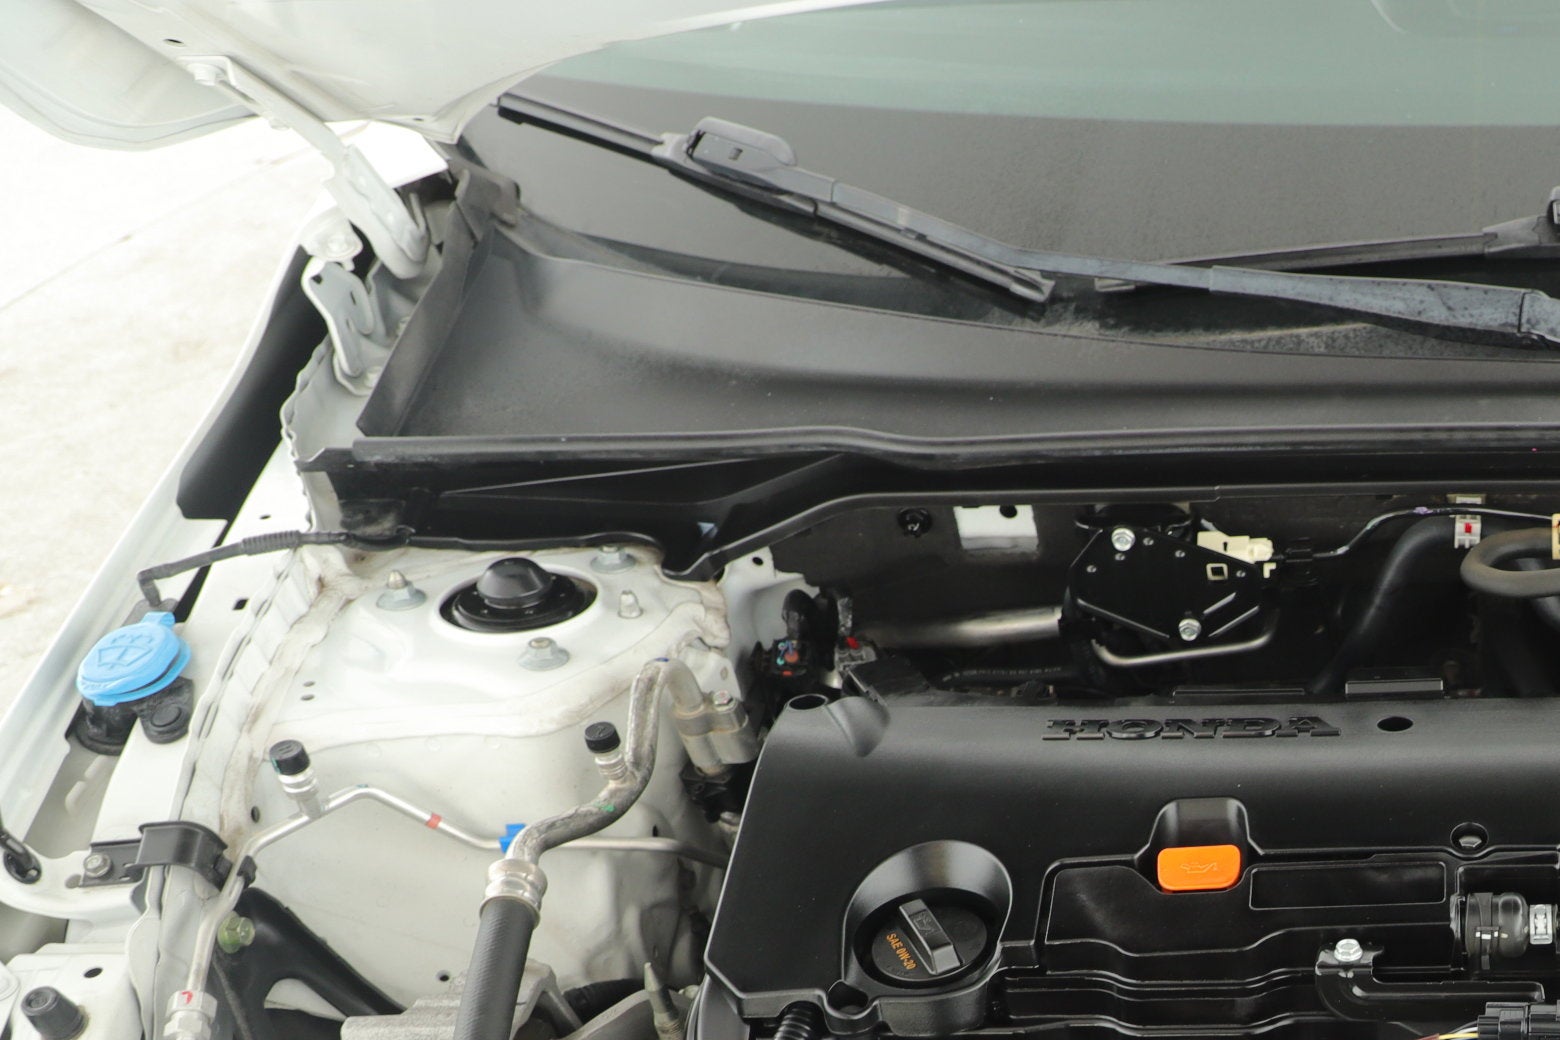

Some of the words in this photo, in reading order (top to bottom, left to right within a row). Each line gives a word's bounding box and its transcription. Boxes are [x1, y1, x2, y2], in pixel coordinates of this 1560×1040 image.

[1042, 715, 1341, 741] HONDA
[886, 933, 904, 950] SAE
[896, 947, 918, 970] 0W-20
